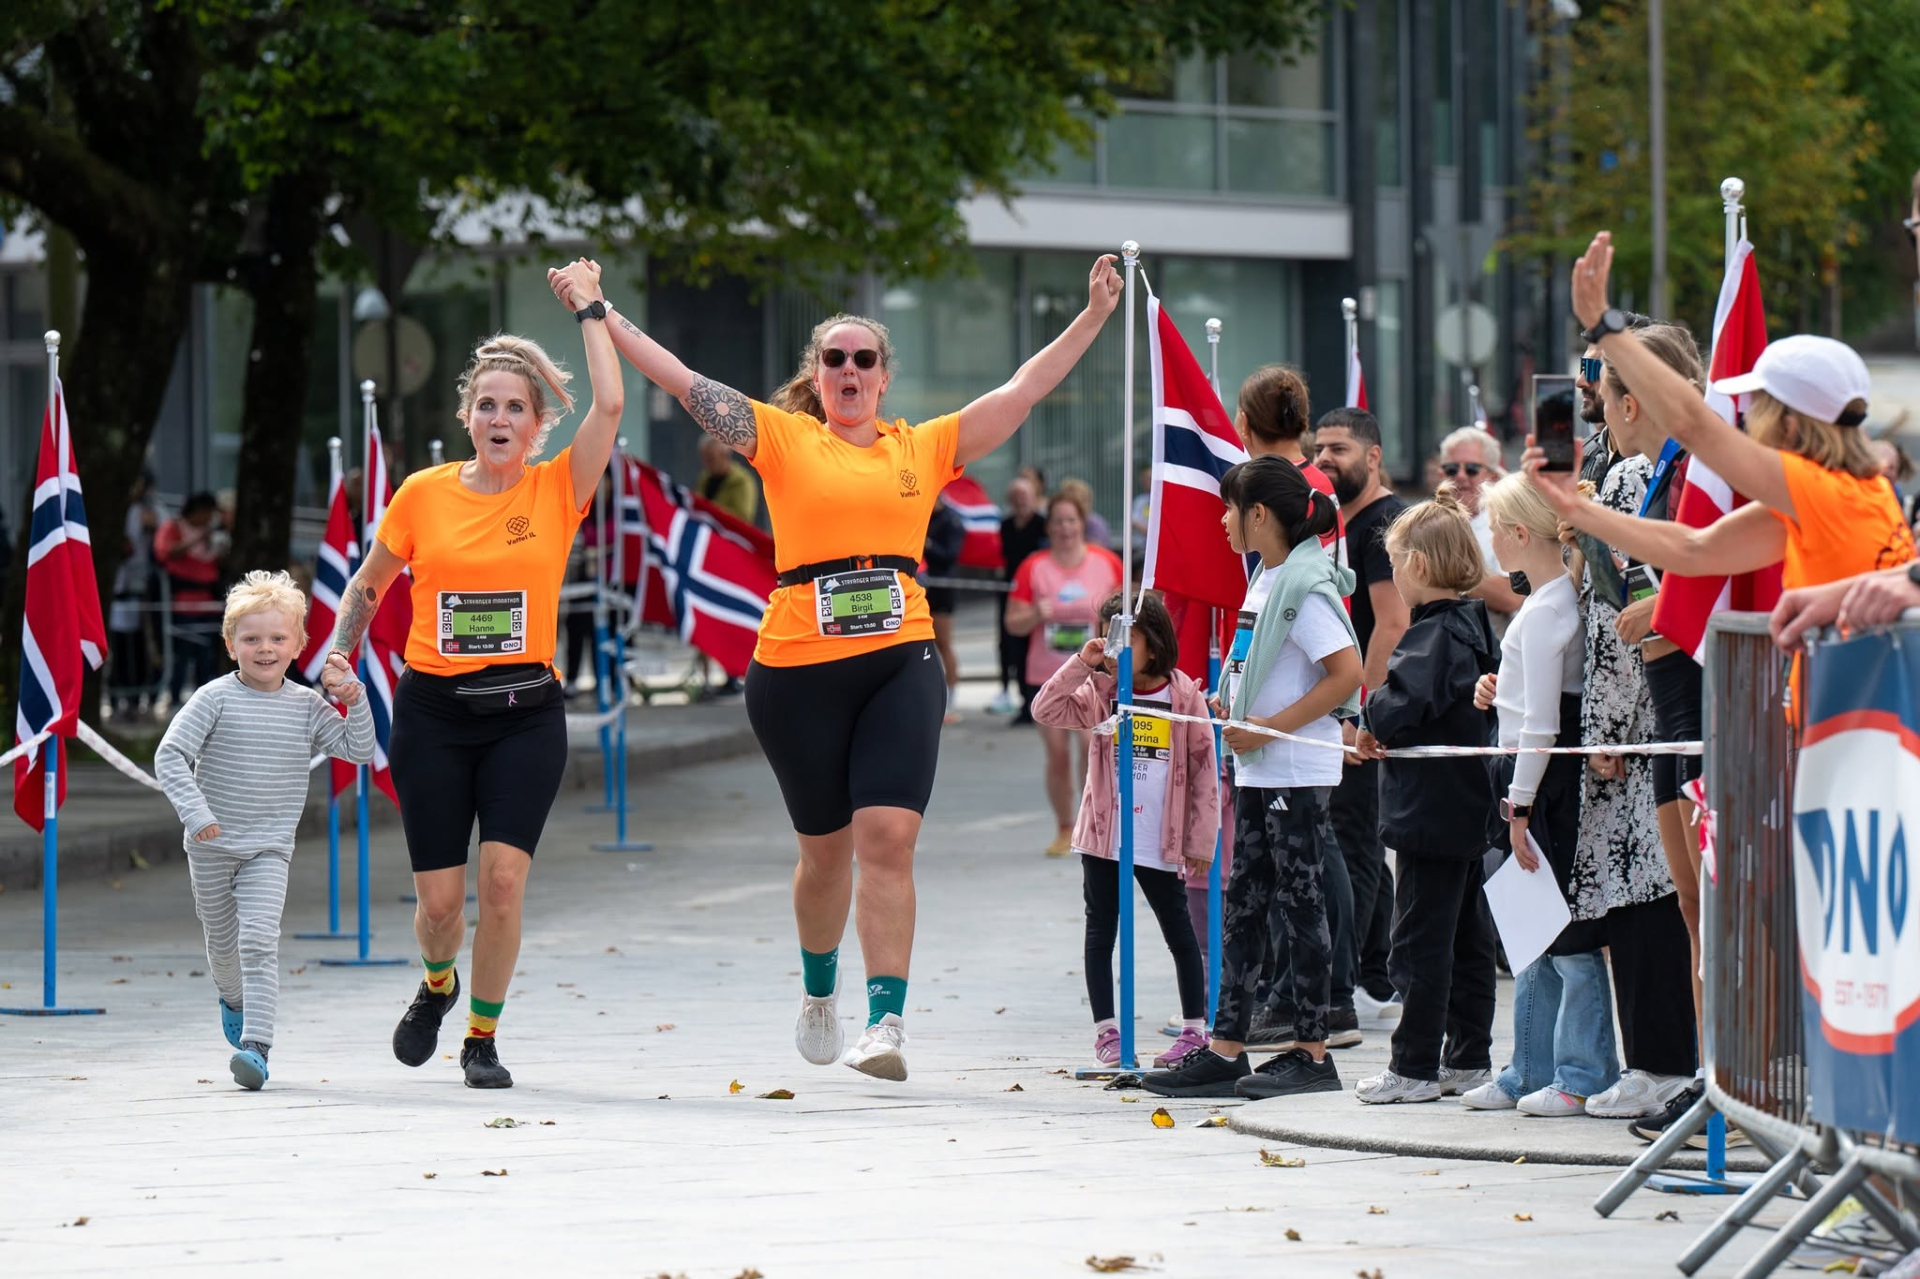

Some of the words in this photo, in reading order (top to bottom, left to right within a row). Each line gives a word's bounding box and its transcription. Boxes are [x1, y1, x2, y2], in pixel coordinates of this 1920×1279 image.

[849, 593, 873, 602] 4538
[851, 603, 874, 613] Birgit
[470, 614, 493, 622] 4469
[885, 619, 900, 627] DNO
[469, 625, 495, 633] Hanne
[503, 641, 519, 649] DNO
[1133, 720, 1153, 731] 095
[1132, 733, 1159, 744] brina
[1794, 808, 1908, 955] DNO
